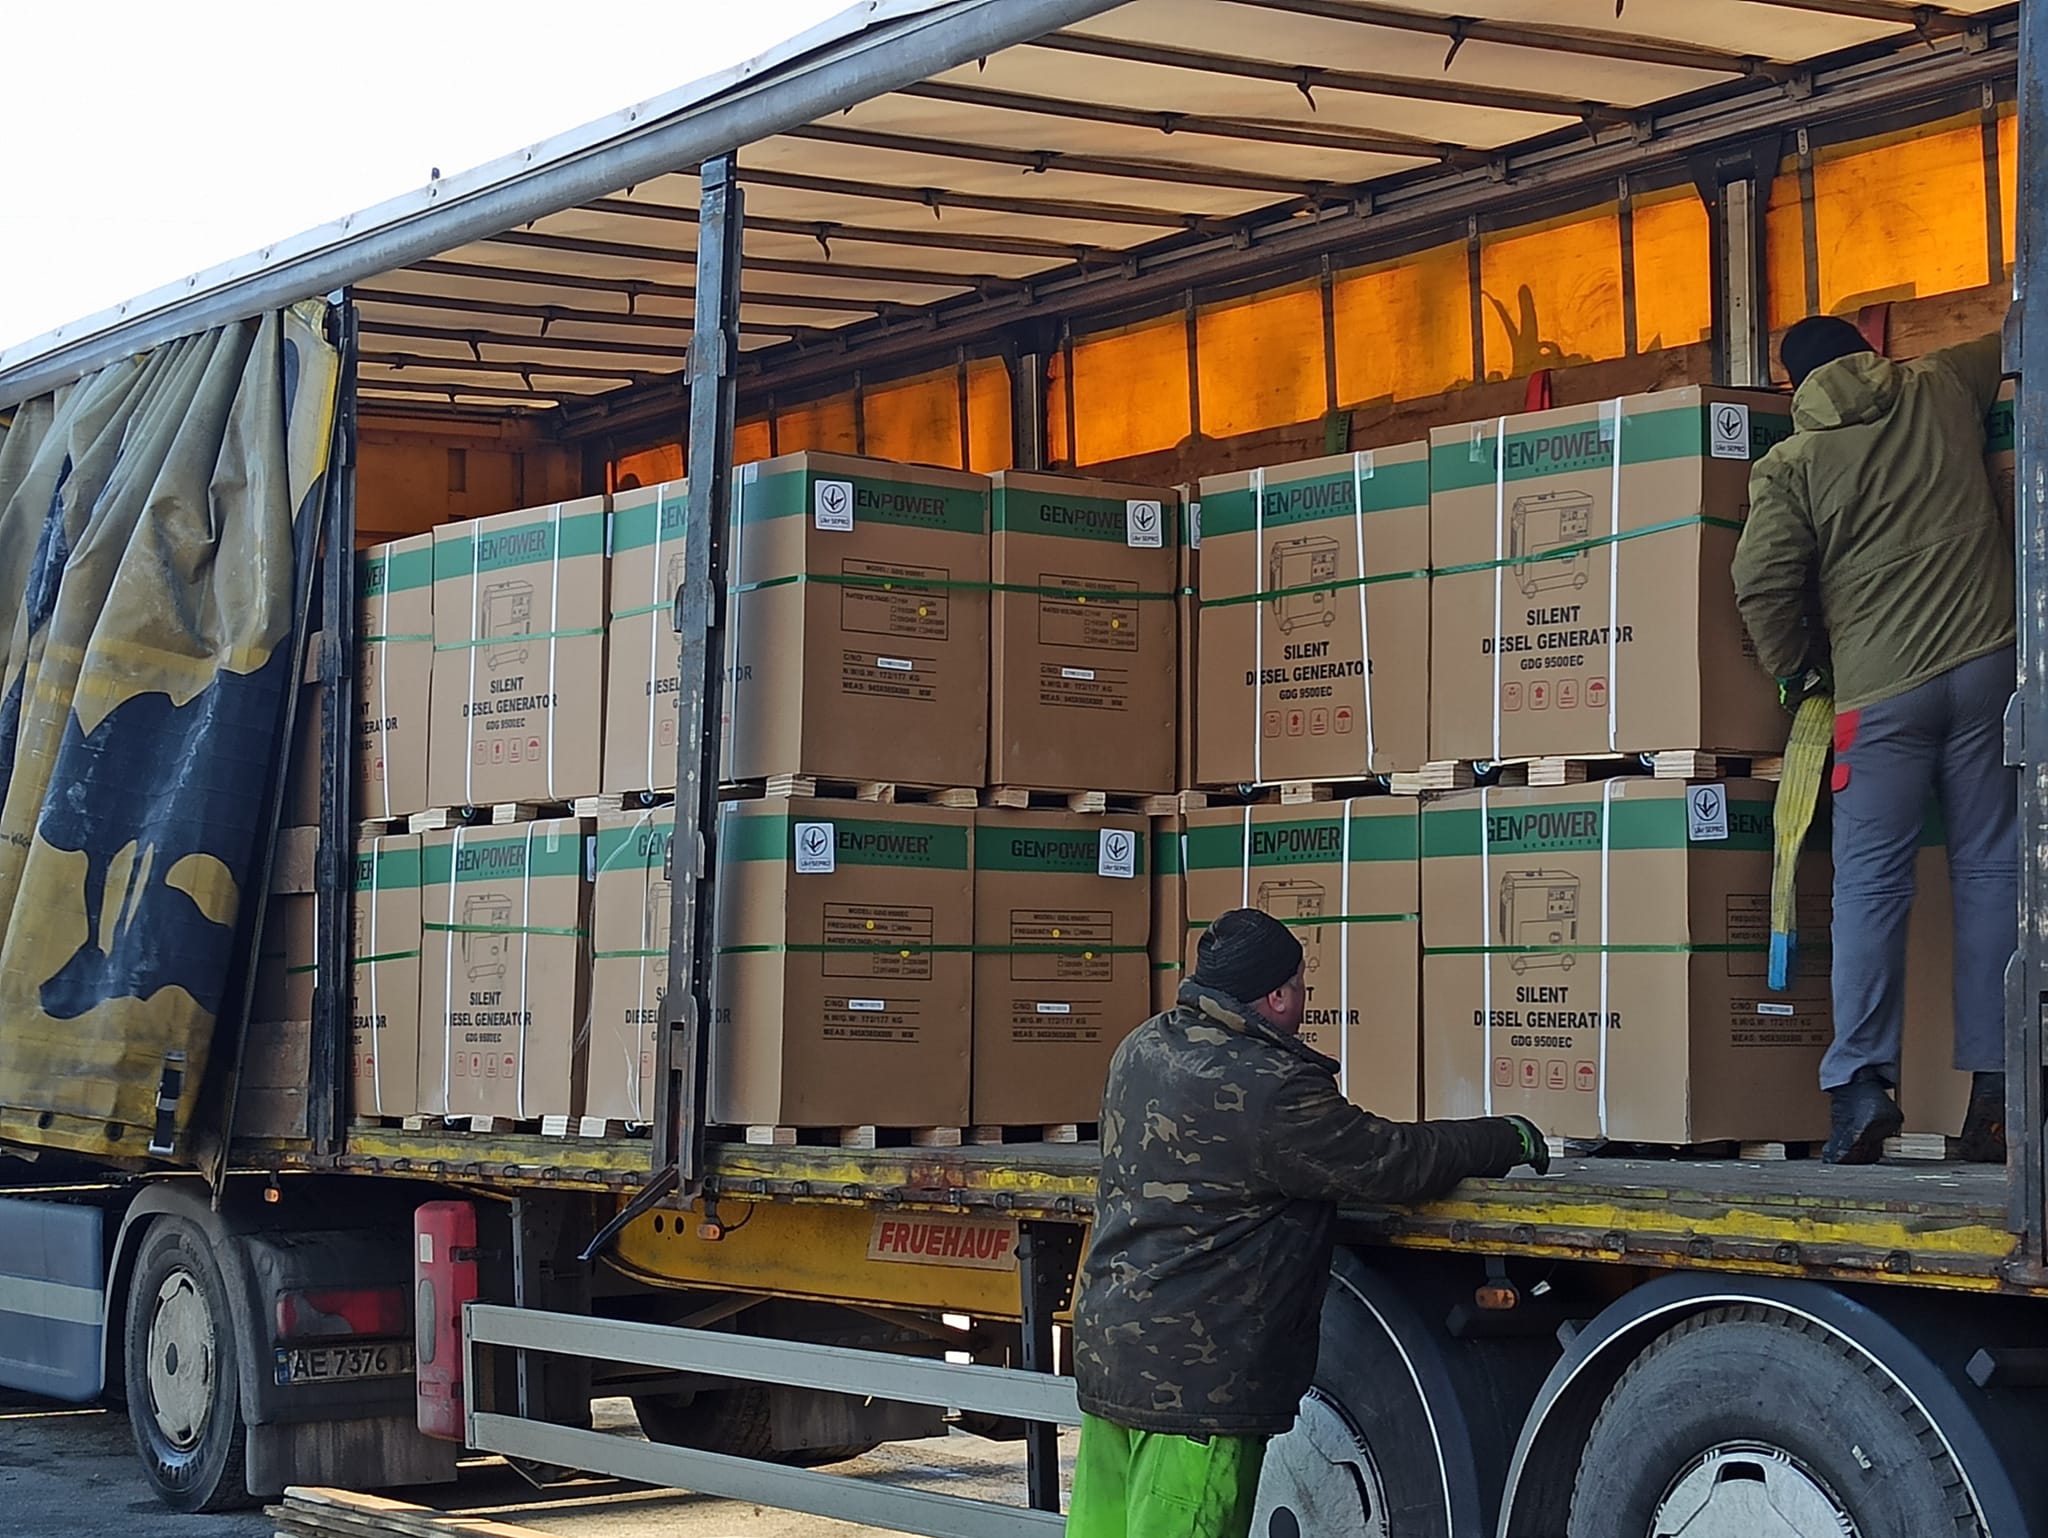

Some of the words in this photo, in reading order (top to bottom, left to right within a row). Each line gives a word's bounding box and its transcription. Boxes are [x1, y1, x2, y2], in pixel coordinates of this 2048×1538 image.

[857, 489, 945, 517] ENPOWER
[1039, 504, 1124, 529] GENPOWE
[1526, 606, 1581, 626] SILENT
[1284, 641, 1330, 660] SILENT
[1520, 658, 1542, 670] GDG
[1544, 655, 1584, 669] 9500EC
[490, 677, 524, 694] SILENT
[1279, 689, 1298, 700] GDG
[1299, 686, 1333, 699] 9500EC
[463, 701, 494, 717] DESEL
[836, 832, 928, 854] ENPOWER
[1011, 839, 1096, 860] GENPOWE
[470, 991, 502, 1006] SILENT
[1516, 986, 1568, 1003] SILENT
[1511, 1035, 1532, 1047] GDG
[1534, 1036, 1573, 1048] 9500EC
[878, 1222, 1011, 1260] FRUEHAUF
[292, 1349, 328, 1378] AE
